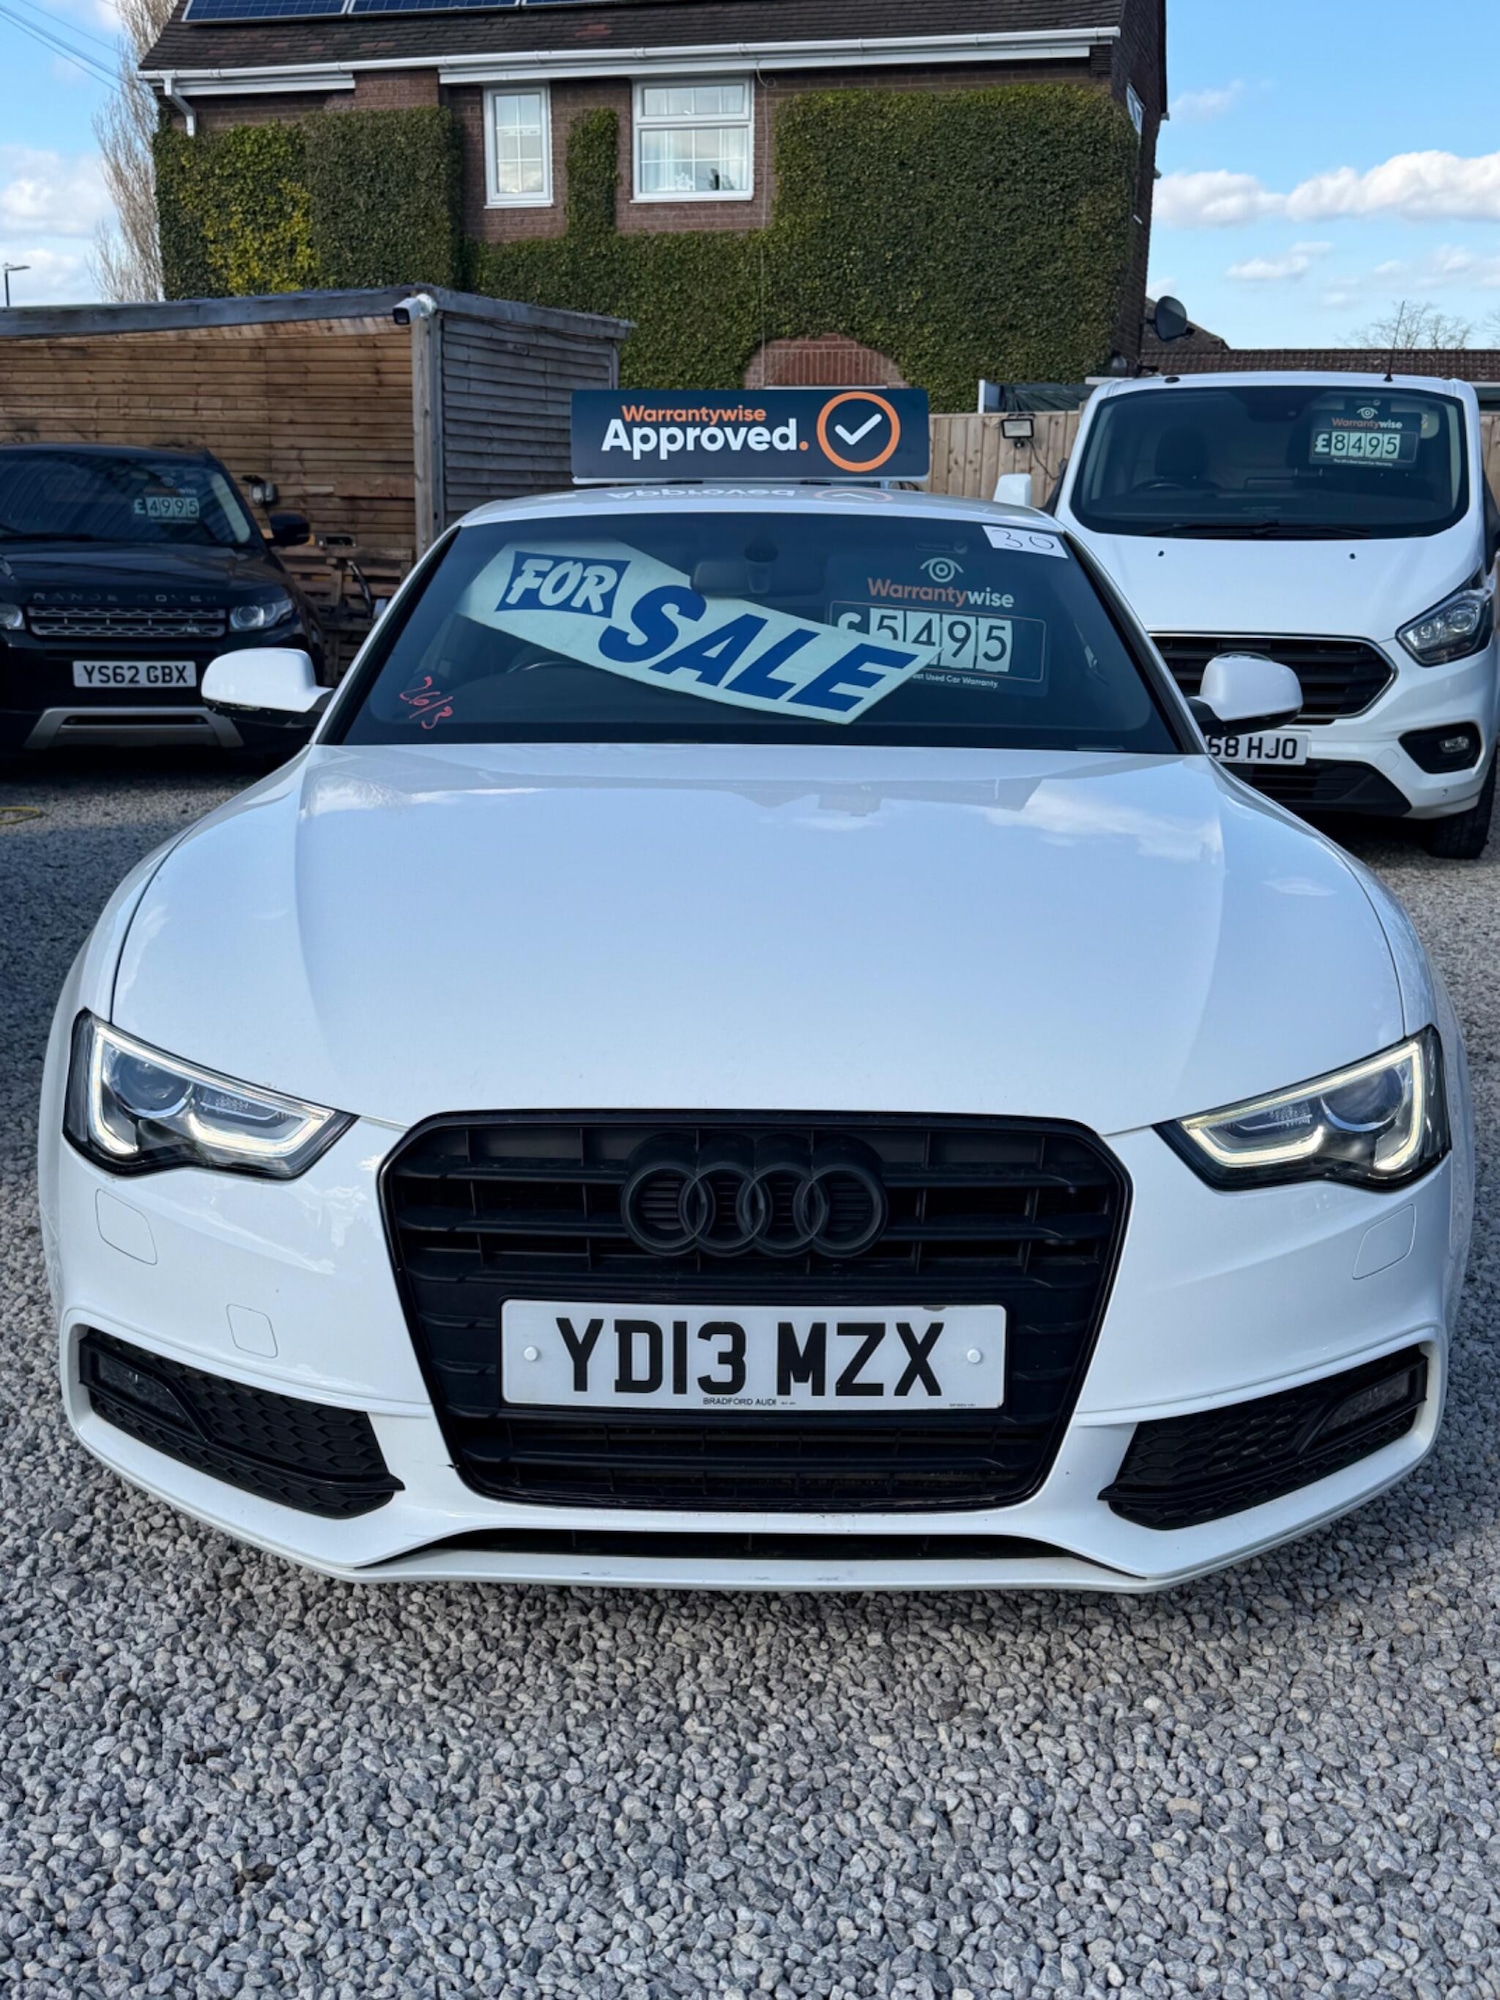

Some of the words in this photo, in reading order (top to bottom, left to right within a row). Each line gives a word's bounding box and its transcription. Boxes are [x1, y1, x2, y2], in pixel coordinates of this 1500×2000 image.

[621, 404, 766, 425] Warrantywise
[1331, 417, 1403, 429] Warrantywise
[601, 418, 809, 460] Approved.
[1315, 433, 1398, 455] £8495
[134, 498, 198, 515] £4995
[992, 529, 1054, 550] 30
[505, 559, 617, 614] FOR
[867, 577, 1014, 608] Warrantywise
[599, 584, 918, 713] SALE
[83, 665, 140, 684] YS62
[146, 665, 187, 684] GBX
[925, 672, 945, 682] Used
[946, 675, 961, 684] Car
[962, 677, 999, 689] Warranty
[1247, 737, 1297, 759] HJO
[555, 1317, 747, 1395] YD13
[777, 1322, 944, 1397] MZX
[703, 1397, 753, 1406] BRADFORD
[755, 1398, 777, 1406] AUDI
